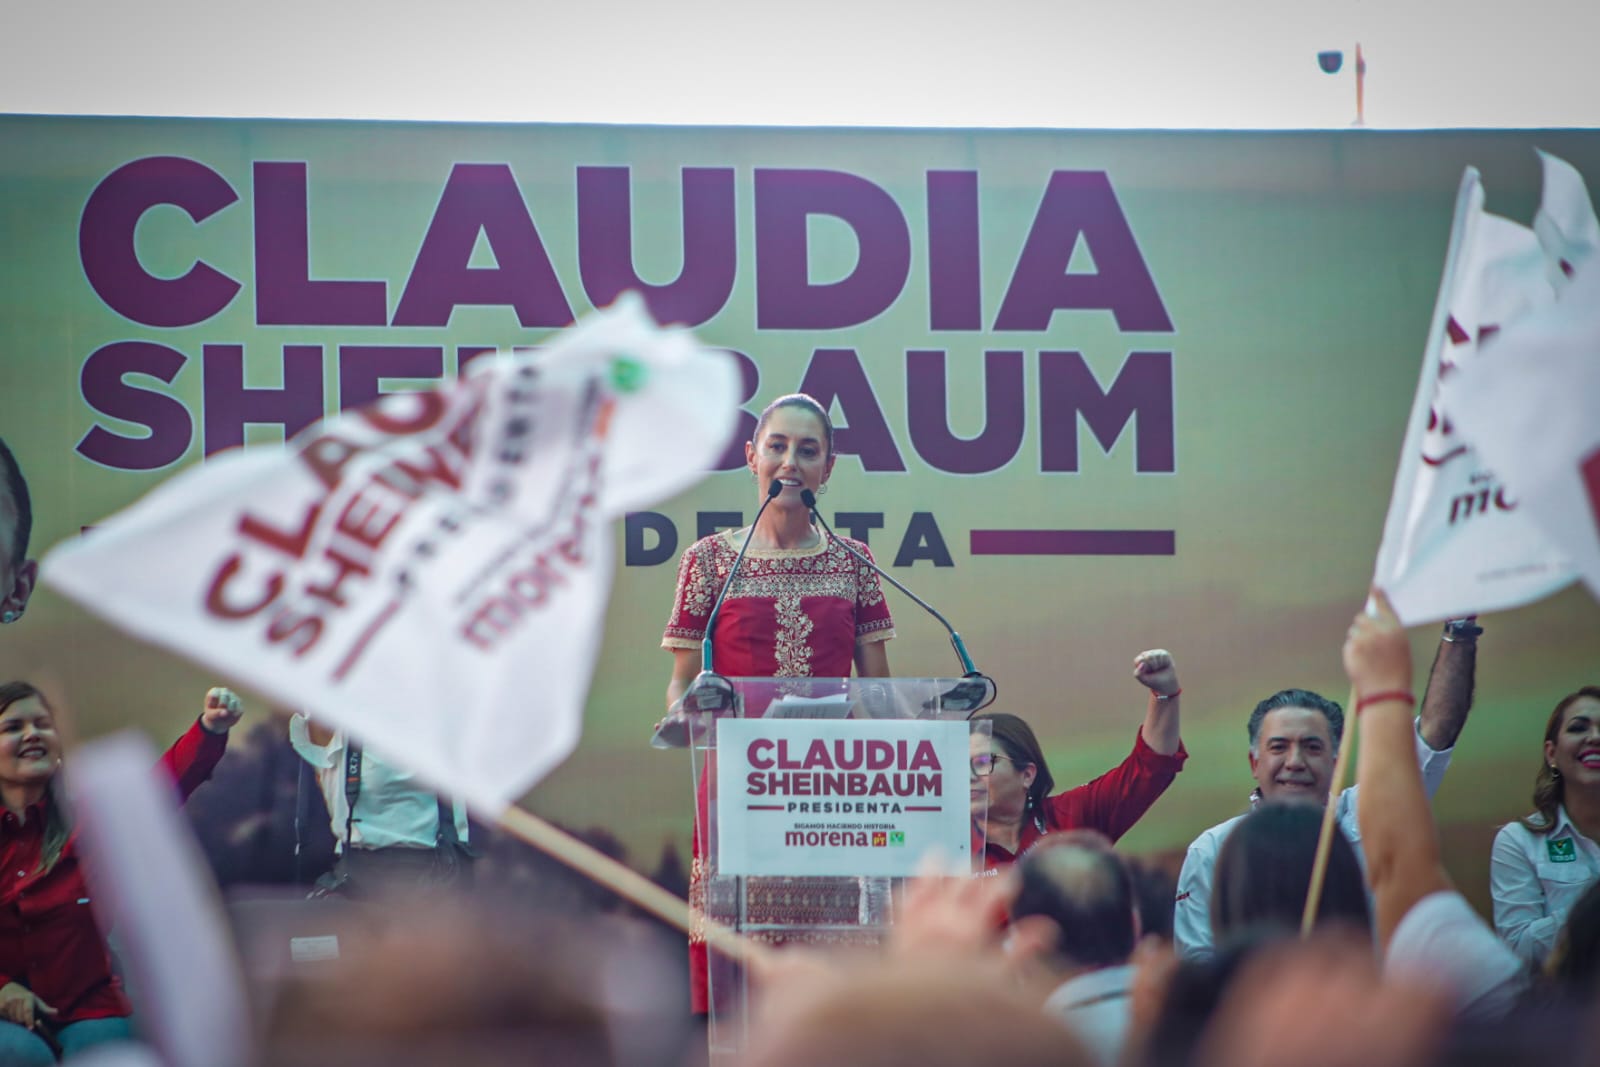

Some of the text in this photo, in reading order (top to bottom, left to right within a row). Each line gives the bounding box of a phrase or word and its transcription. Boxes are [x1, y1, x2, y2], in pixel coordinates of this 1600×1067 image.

[79, 156, 1175, 332] CLAUDIA
[76, 341, 1176, 474] SHAUM
[747, 739, 942, 771] CLAUDIA
[747, 772, 942, 796] SHEINBAUM
[788, 802, 902, 813] PRESIDENTA
[785, 831, 885, 846] morena PT
